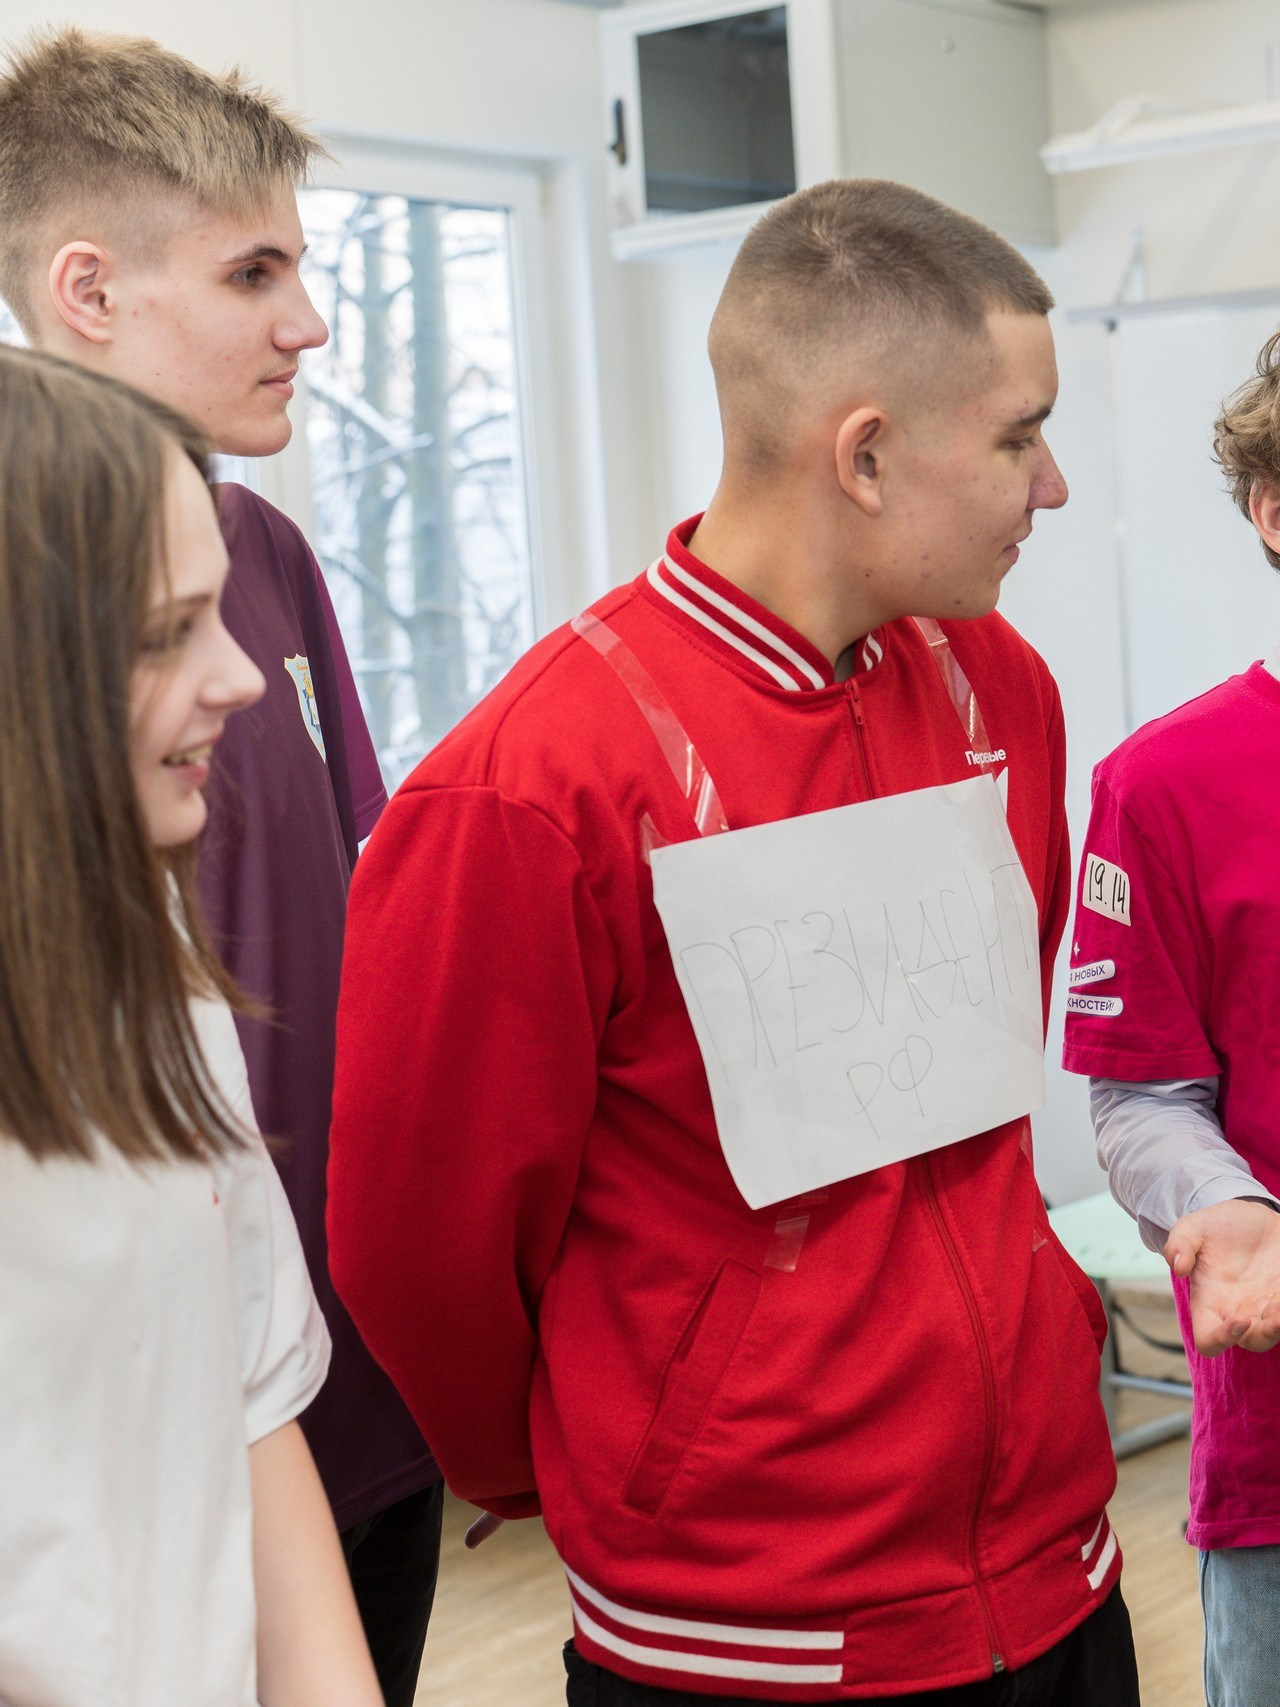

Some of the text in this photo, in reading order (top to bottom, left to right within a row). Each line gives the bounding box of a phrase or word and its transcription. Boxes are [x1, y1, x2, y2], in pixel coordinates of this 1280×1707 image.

[965, 749, 1006, 768] Первые
[1088, 860, 1126, 914] 19.14
[679, 862, 1030, 1085] ПРЕЗИДЕНТ
[1074, 964, 1106, 982] НОВЫХ
[846, 1034, 934, 1140] РФ
